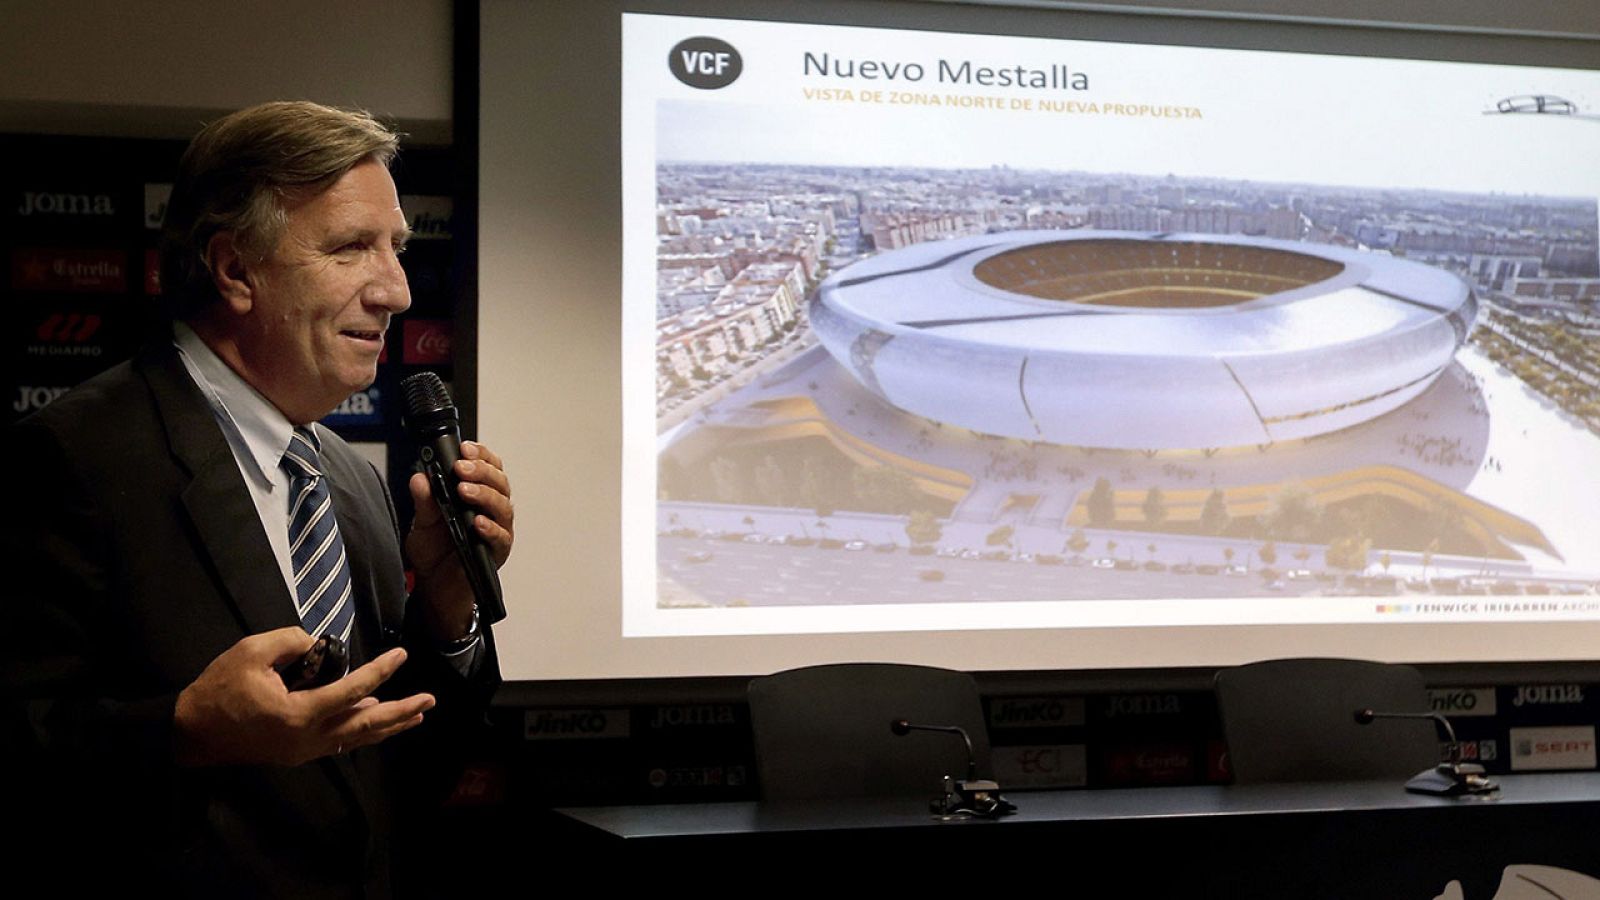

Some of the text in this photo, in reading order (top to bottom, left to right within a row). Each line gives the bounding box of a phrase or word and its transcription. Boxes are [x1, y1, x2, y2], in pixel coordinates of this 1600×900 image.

[681, 50, 730, 75] VCF
[803, 52, 1090, 91] Nuevo Mestalla
[803, 88, 1202, 119] VISTA DE ZONA NORTE DE NUEVA PROPUESTA
[27, 346, 102, 356] MEDIAPRO
[1416, 604, 1478, 612] FENWICK
[1484, 603, 1558, 612] IRIBARREN
